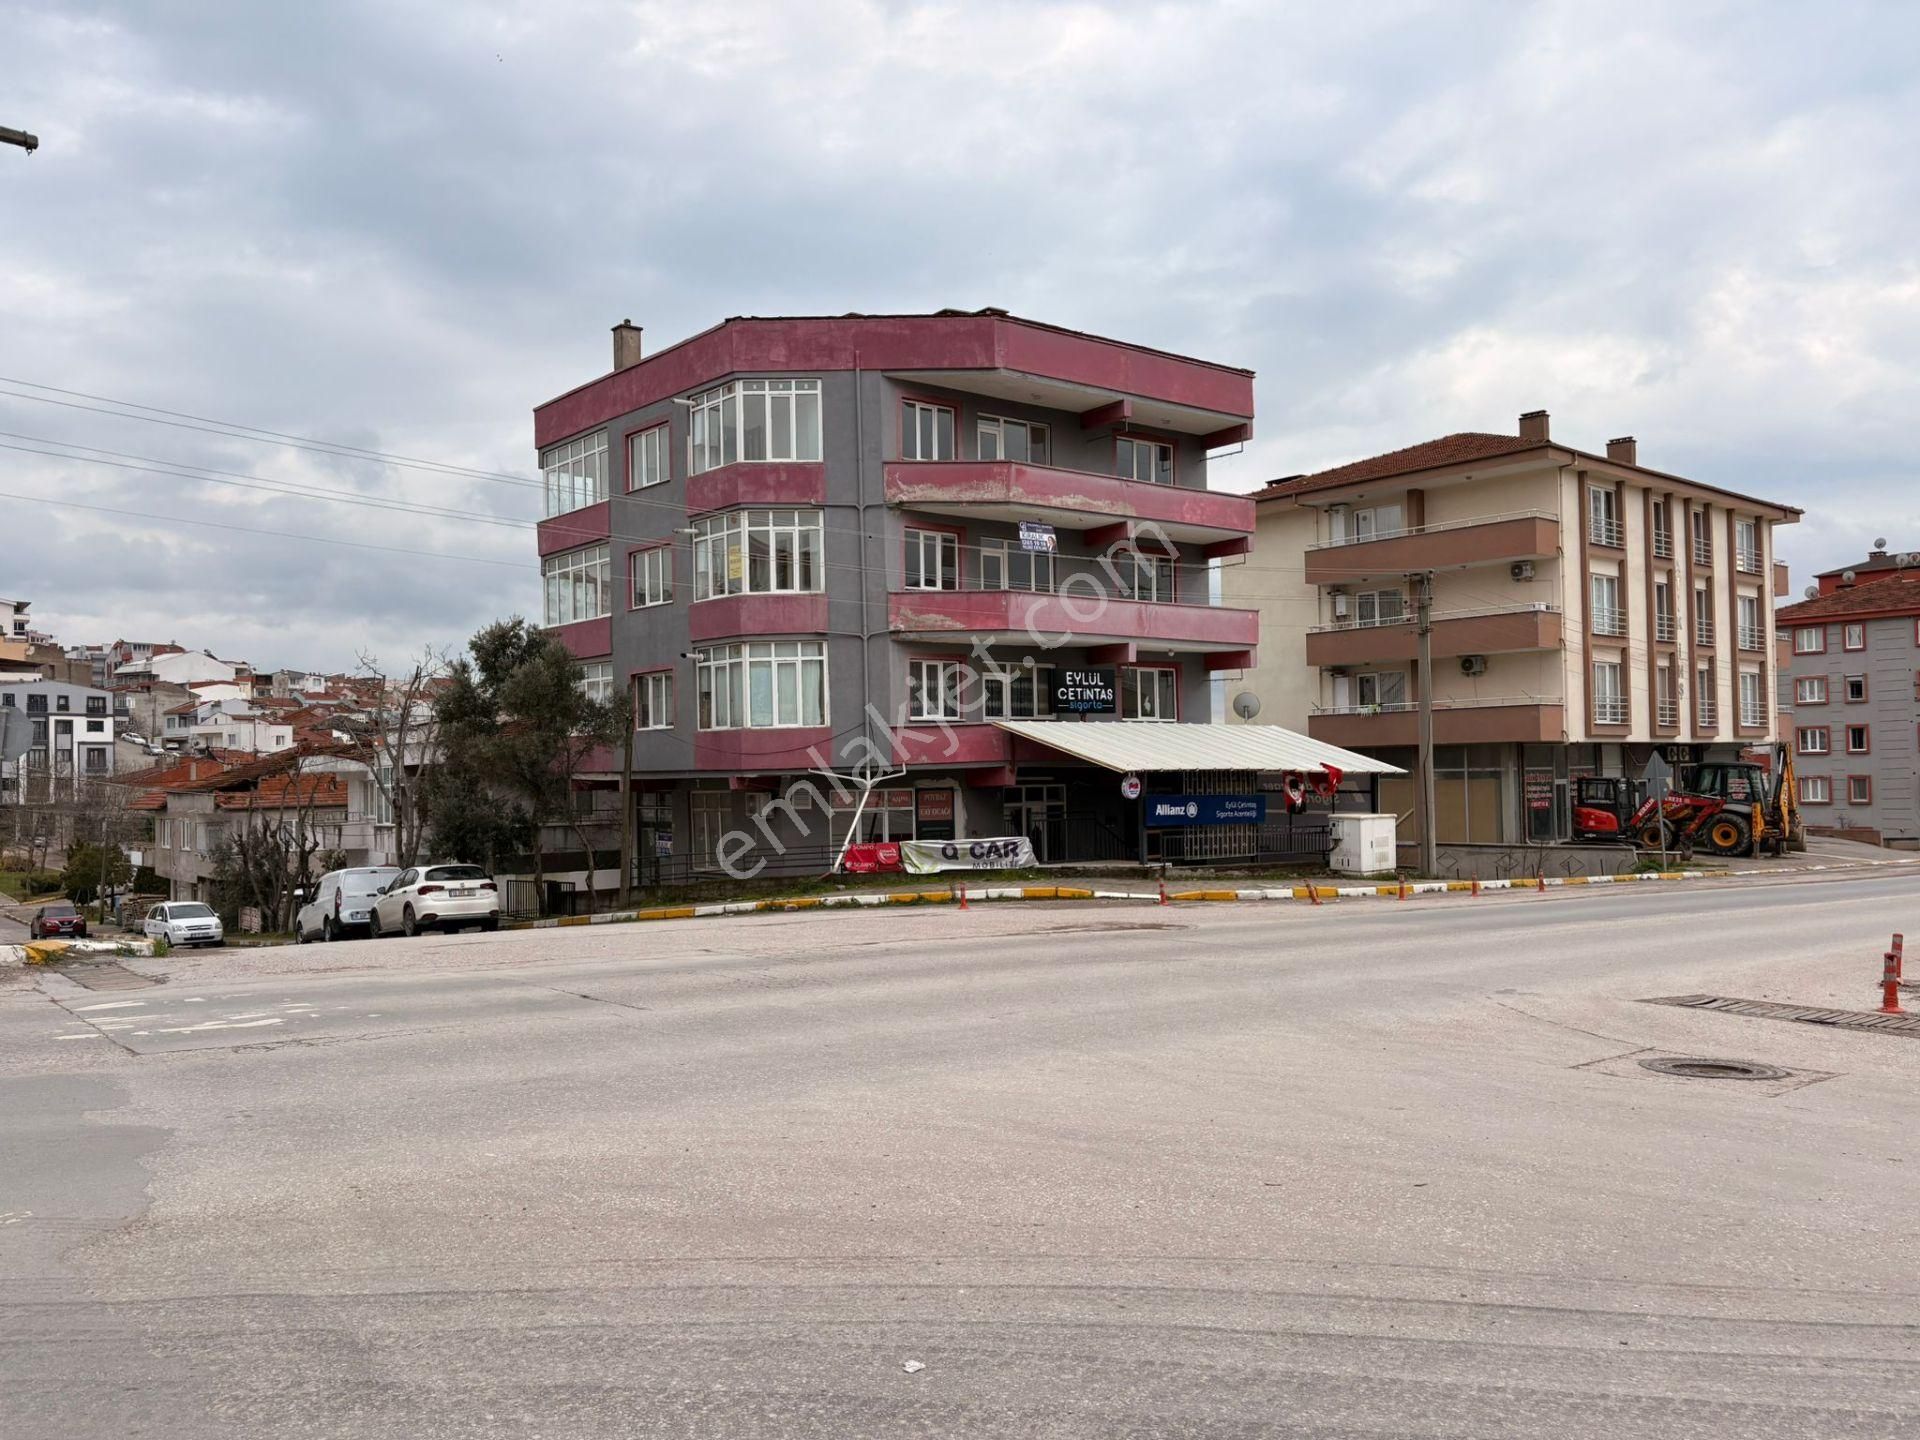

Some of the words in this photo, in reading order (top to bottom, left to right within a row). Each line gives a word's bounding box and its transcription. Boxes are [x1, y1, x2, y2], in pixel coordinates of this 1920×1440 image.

[1066, 672, 1104, 685] EYLÜL
[1069, 700, 1103, 711] sigorta
[1156, 804, 1185, 816] Allianz
[941, 843, 959, 860] Q
[969, 841, 1019, 860] CAR
